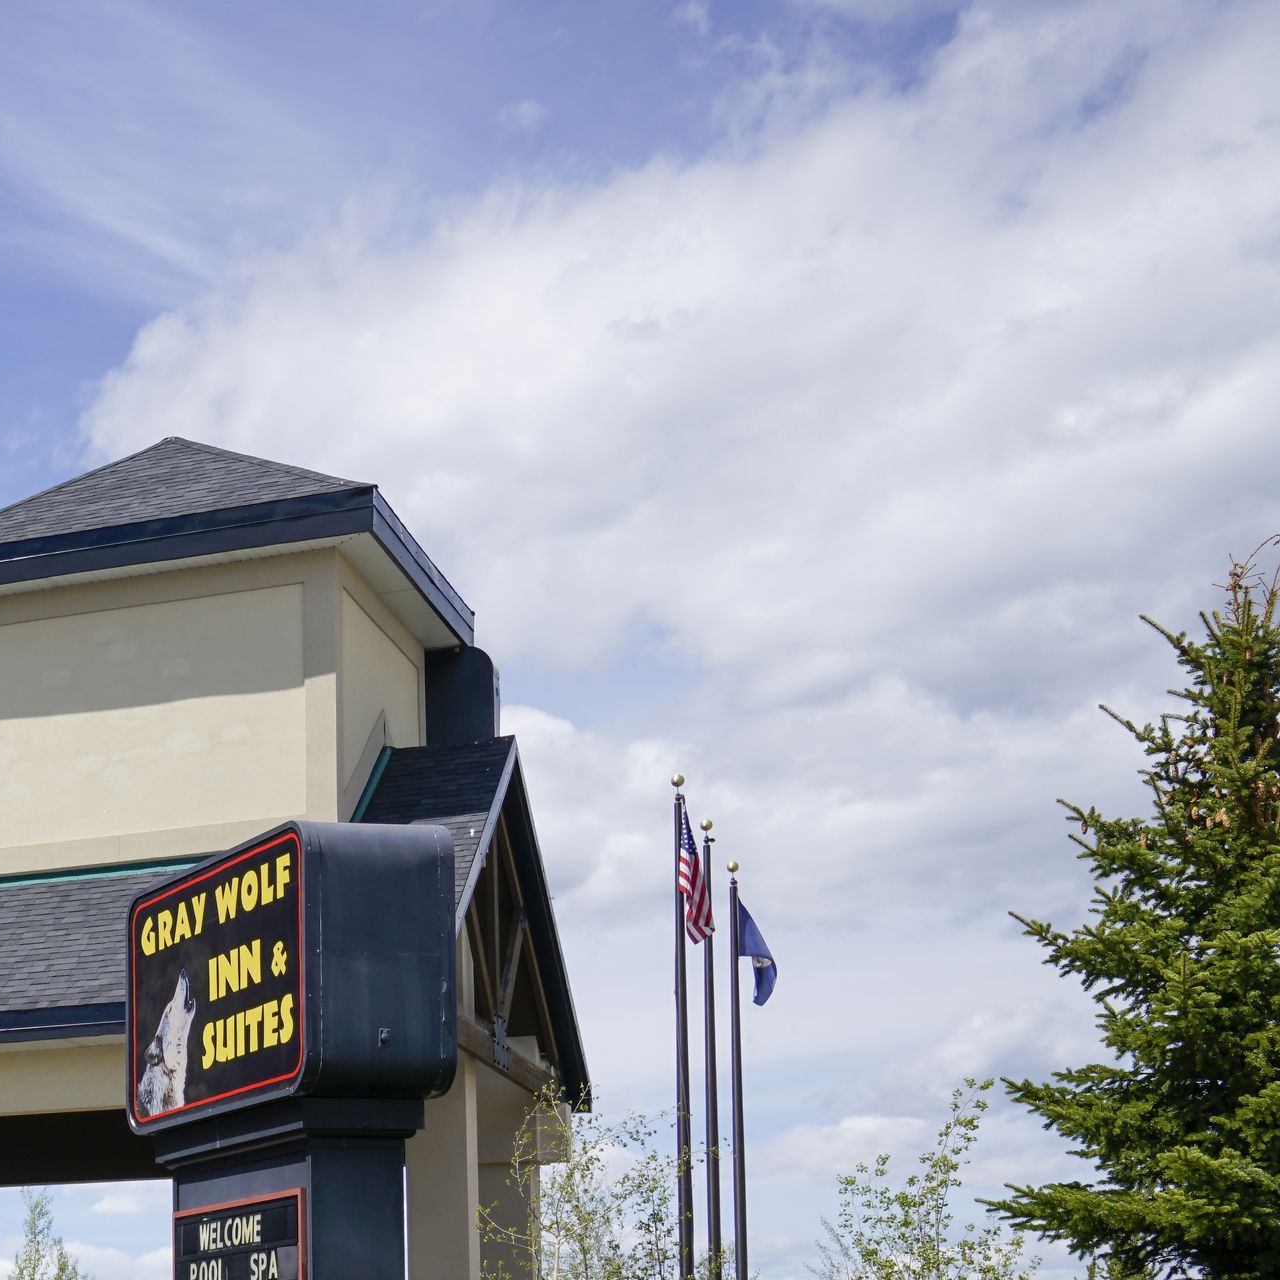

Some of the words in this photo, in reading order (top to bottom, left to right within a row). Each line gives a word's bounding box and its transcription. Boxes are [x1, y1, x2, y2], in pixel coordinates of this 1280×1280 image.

[141, 893, 206, 956] GRAY
[215, 853, 290, 924] WOLF
[208, 939, 262, 1002] INN
[271, 941, 287, 976] &
[201, 994, 294, 1070] SUITES
[199, 1214, 261, 1251] WELCOME
